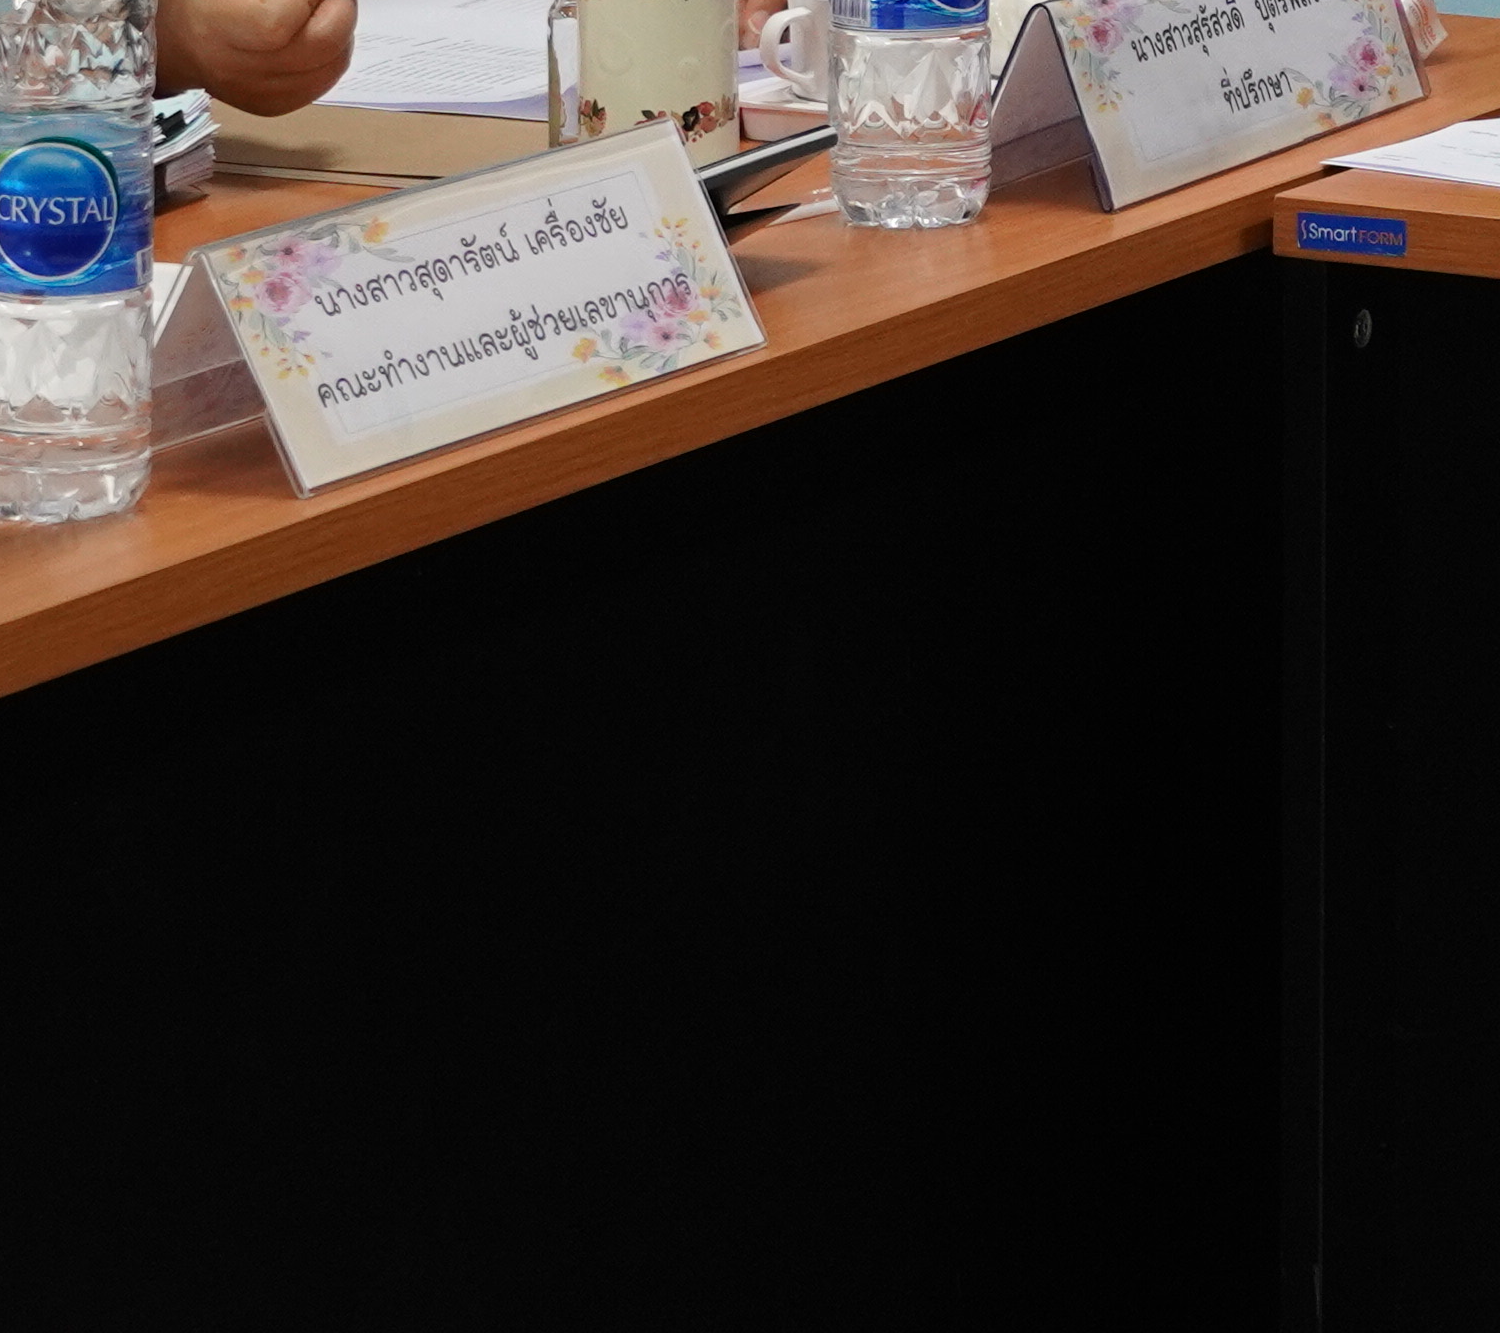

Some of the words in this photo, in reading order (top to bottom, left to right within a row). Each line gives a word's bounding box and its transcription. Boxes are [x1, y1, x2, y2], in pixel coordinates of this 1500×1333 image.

[1220, 67, 1293, 113] ที่ปรึกษา
[314, 222, 520, 317] นางสาวสุดารัตน์
[524, 197, 629, 255] เครื่องชัย
[317, 272, 692, 408] คณะทำงานและผู้ช่วยเลขานุการ
